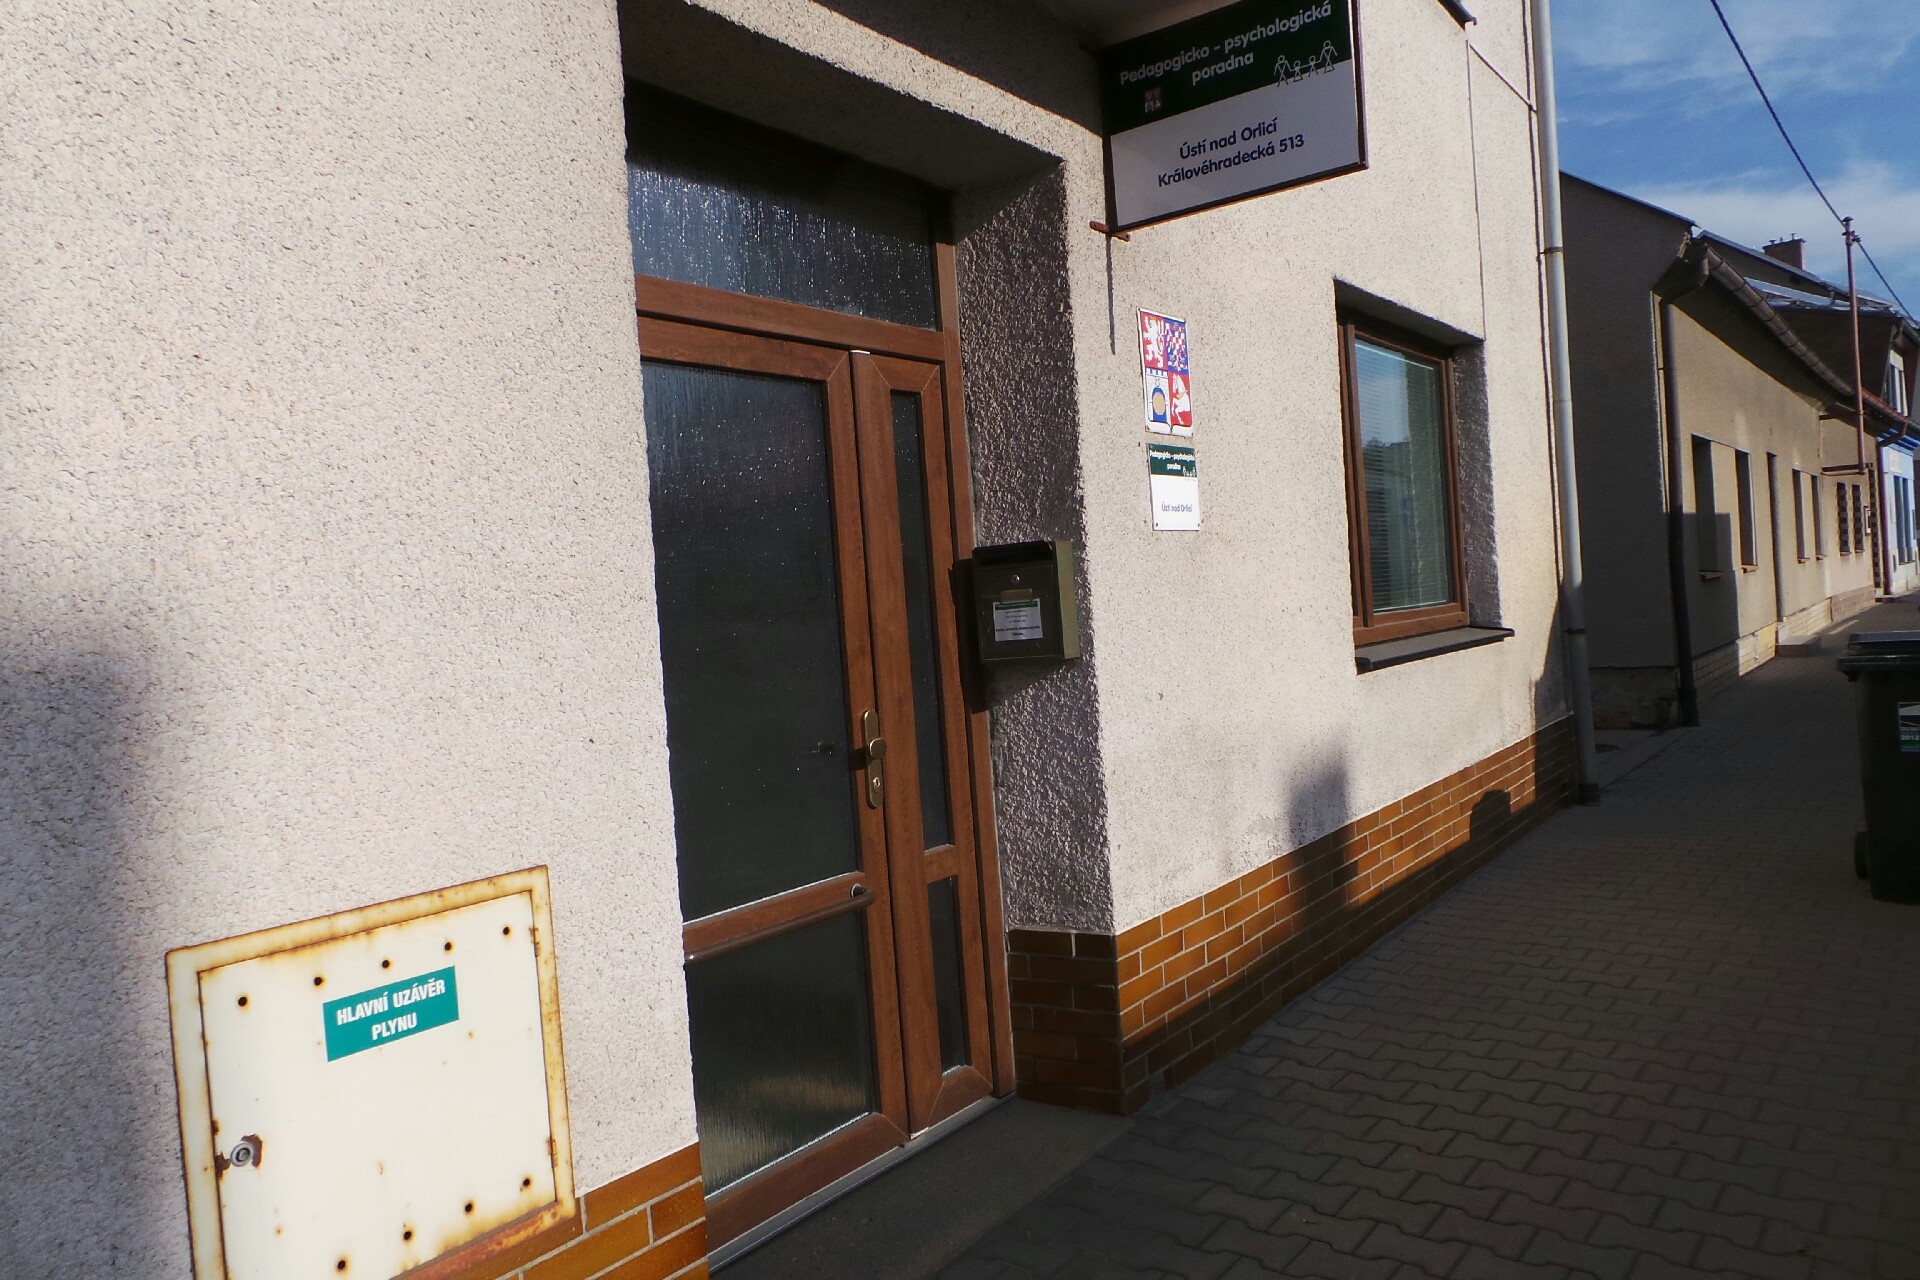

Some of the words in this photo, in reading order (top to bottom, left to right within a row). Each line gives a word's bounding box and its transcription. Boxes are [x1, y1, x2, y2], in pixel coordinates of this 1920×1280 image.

[1120, 46, 1210, 86] Pedagogicko
[1224, 1, 1332, 54] psychologická
[1192, 50, 1254, 86] poradna
[1179, 138, 1207, 160] Ústí
[1209, 130, 1237, 152] nad
[1240, 116, 1278, 142] Orlicí
[1158, 141, 1276, 188] Královéhradecká
[1279, 133, 1305, 153] 513
[1171, 504, 1180, 512] nad
[336, 991, 389, 1026] HLAVNÍ
[392, 977, 446, 1008] UZÁVĚR
[371, 1012, 418, 1041] PLYNU
